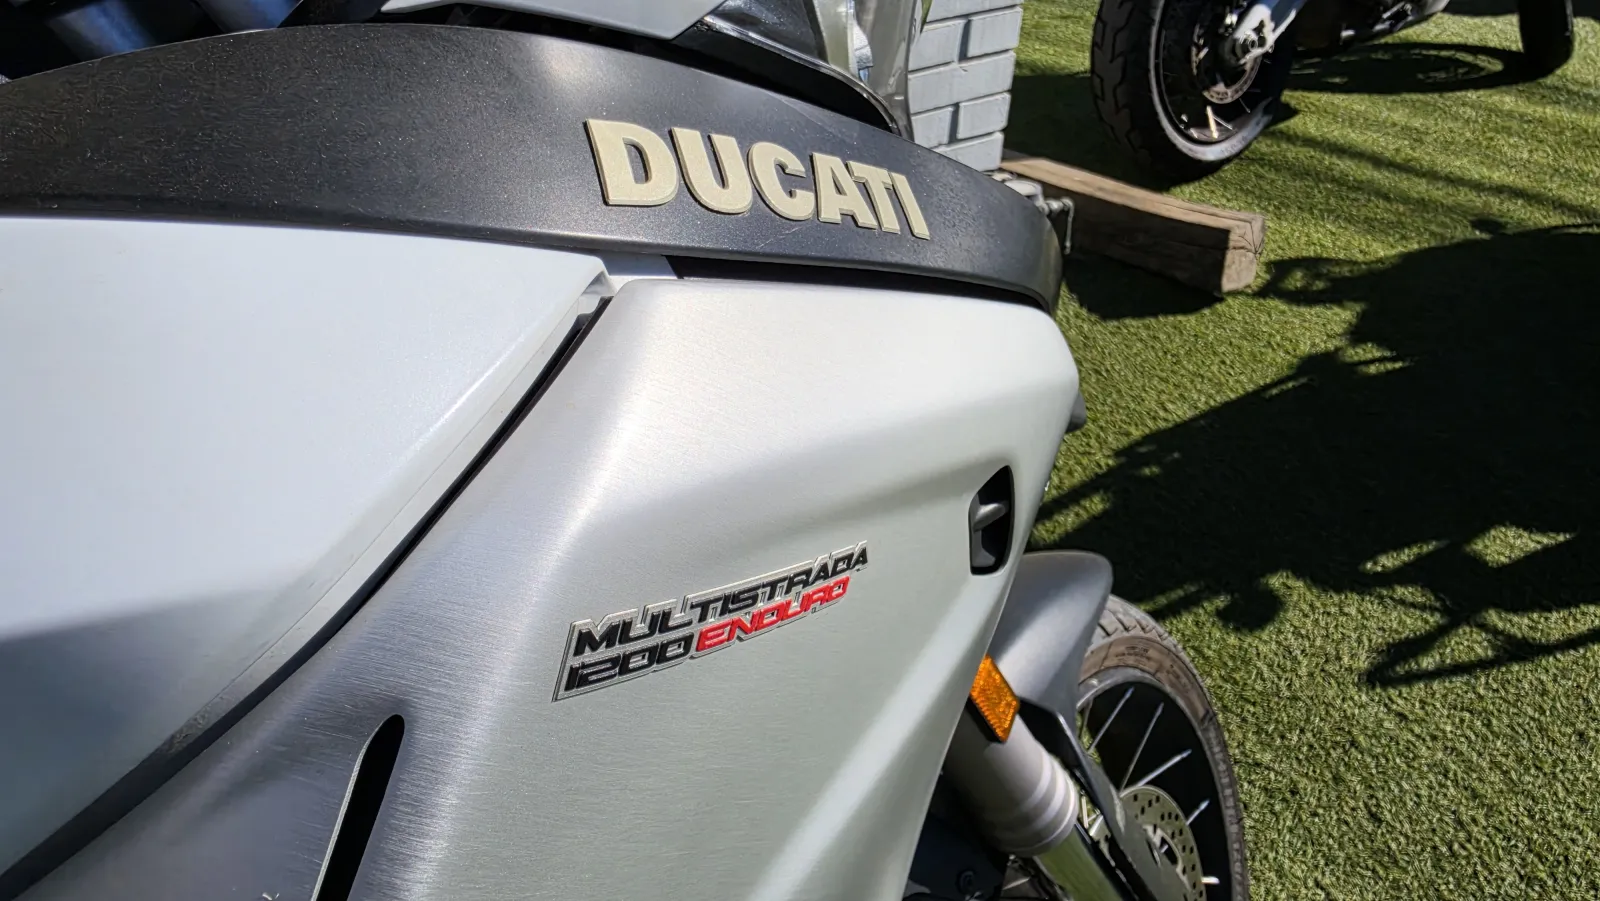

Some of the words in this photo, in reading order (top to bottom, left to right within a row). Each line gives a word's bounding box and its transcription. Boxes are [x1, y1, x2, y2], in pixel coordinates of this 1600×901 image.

[585, 118, 930, 240] DUCATI
[564, 631, 695, 692] 1200
[695, 575, 850, 652] ENDURO
[573, 545, 868, 657] MULTISTRADA
